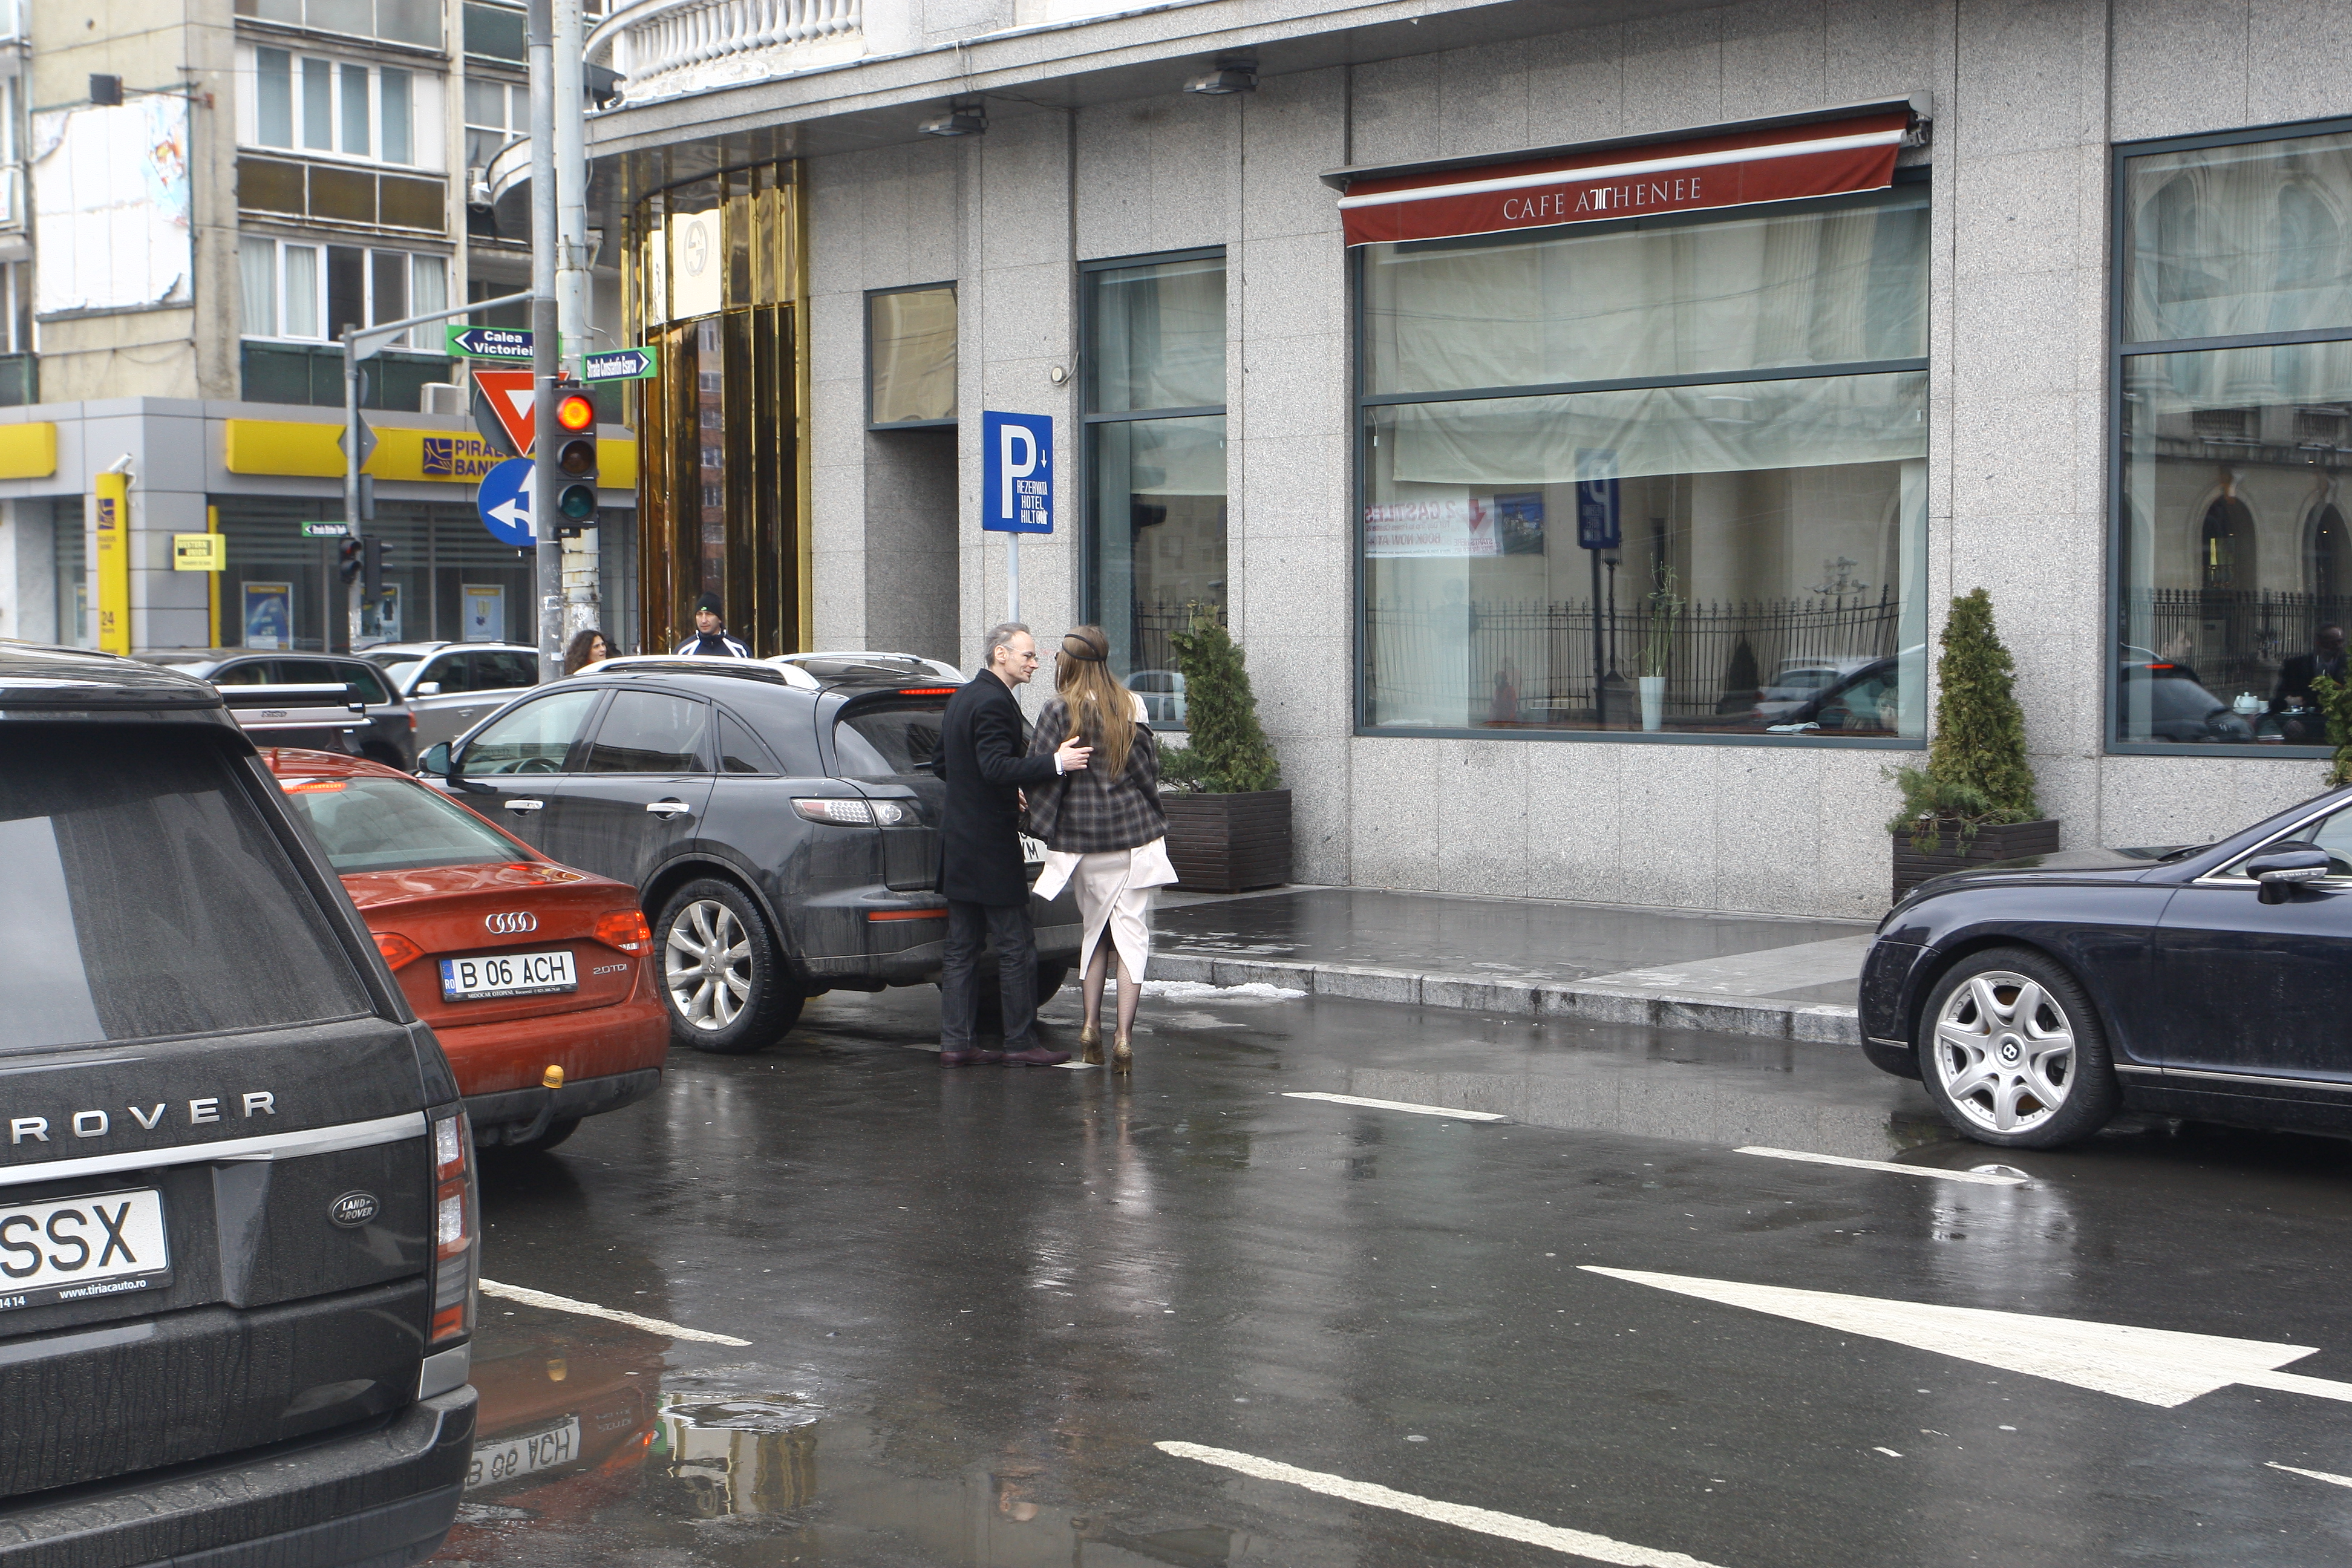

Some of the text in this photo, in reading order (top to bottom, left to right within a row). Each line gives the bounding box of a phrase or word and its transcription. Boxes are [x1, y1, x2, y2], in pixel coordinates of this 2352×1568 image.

[1503, 194, 1564, 220] CAFE
[483, 330, 523, 344] Calea
[473, 342, 533, 356] Victoriei
[456, 439, 517, 458] PIRA
[1001, 424, 1037, 519] P
[1016, 480, 1048, 495] REZERVATA
[1021, 495, 1044, 510] HOTEL
[460, 955, 567, 988] B 06 ACH
[445, 979, 455, 990] RO
[10, 1091, 276, 1145] ROVER
[342, 1198, 366, 1211] LAND
[344, 1207, 373, 1221] ROVER
[60, 1279, 146, 1299] www.tiriacauto.ro
